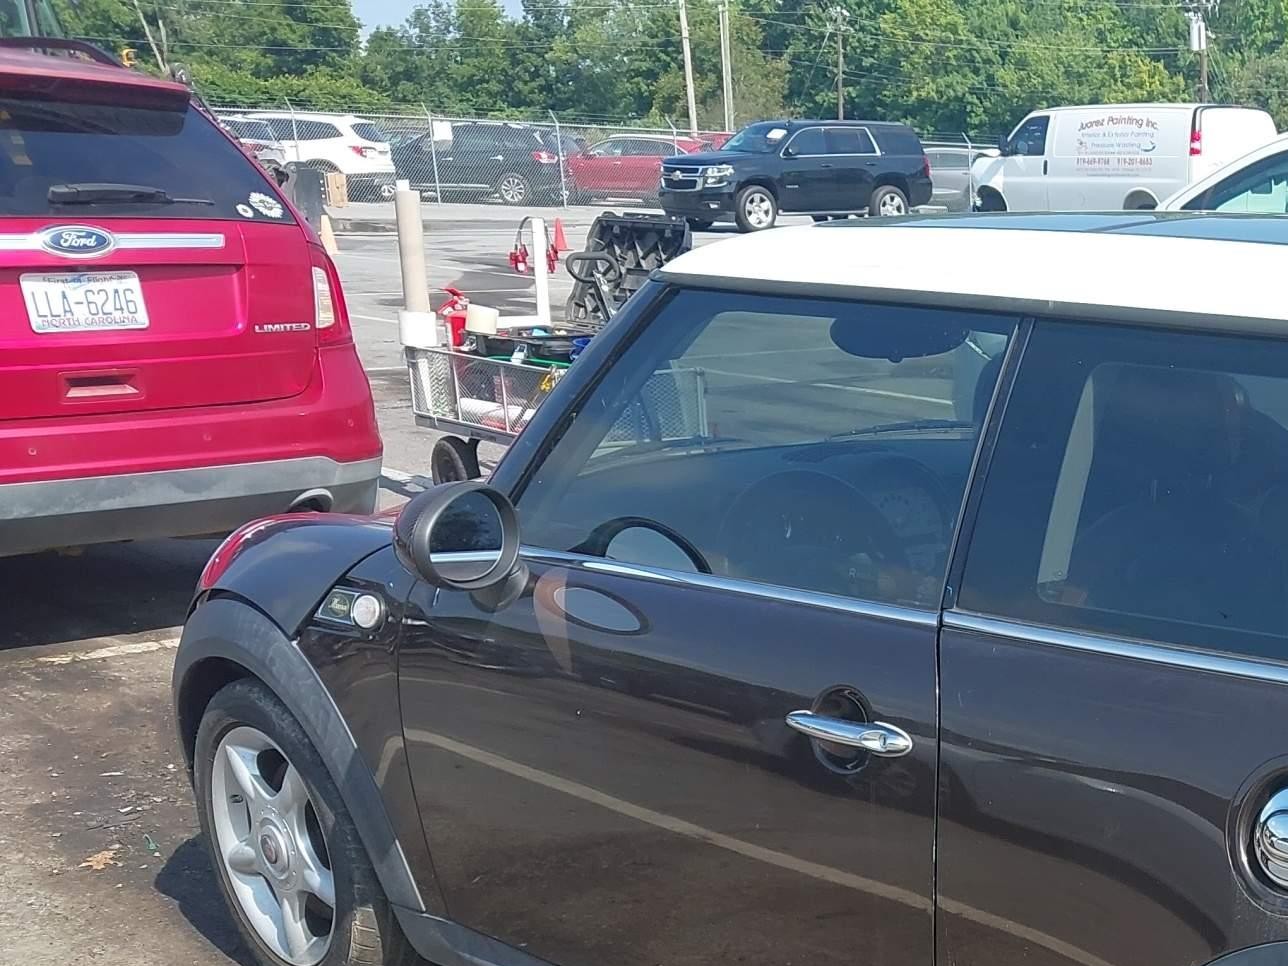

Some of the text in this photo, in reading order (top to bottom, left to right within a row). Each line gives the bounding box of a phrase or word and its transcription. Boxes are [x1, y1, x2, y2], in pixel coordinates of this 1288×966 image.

[1078, 118, 1105, 132] Juarez
[1107, 115, 1144, 128] Painting
[60, 231, 97, 247] Ford
[31, 288, 138, 318] LLA-6246
[42, 315, 138, 328] NORTH CAROLINA
[254, 323, 311, 333] LIMITED
